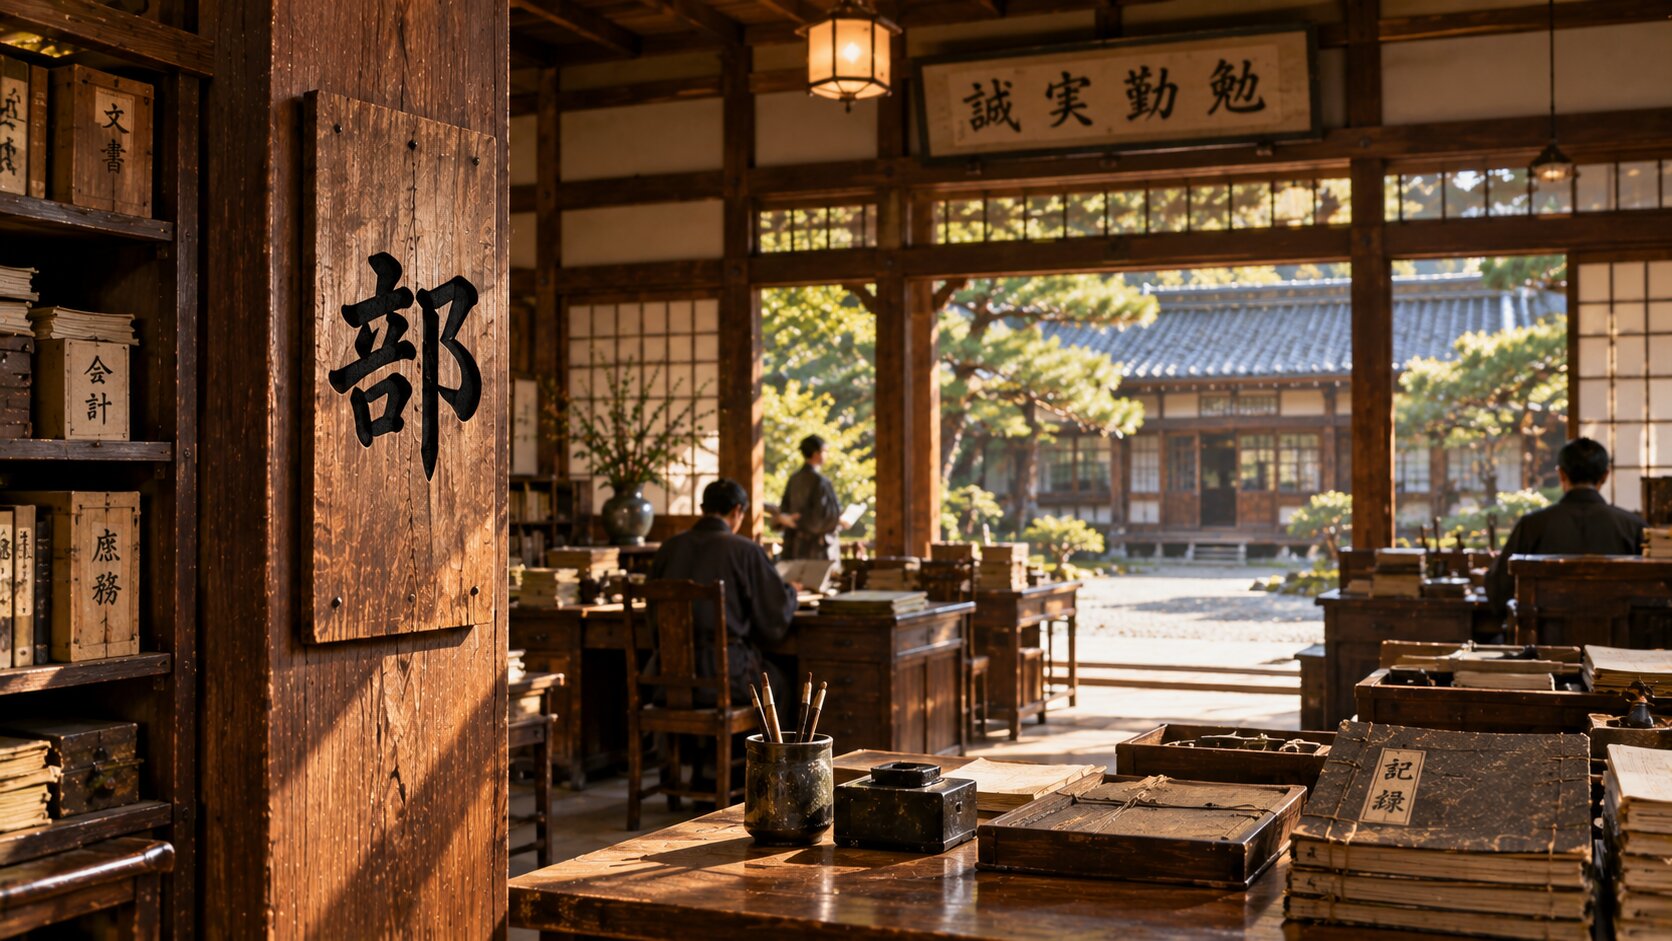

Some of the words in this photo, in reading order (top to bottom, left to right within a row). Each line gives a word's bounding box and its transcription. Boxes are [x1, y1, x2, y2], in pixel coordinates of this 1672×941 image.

[963, 58, 1266, 133] 誠実勤勉
[101, 103, 130, 174] 文書
[84, 355, 114, 425] 会計
[328, 251, 482, 482] 部
[1372, 758, 1414, 813] 記録
